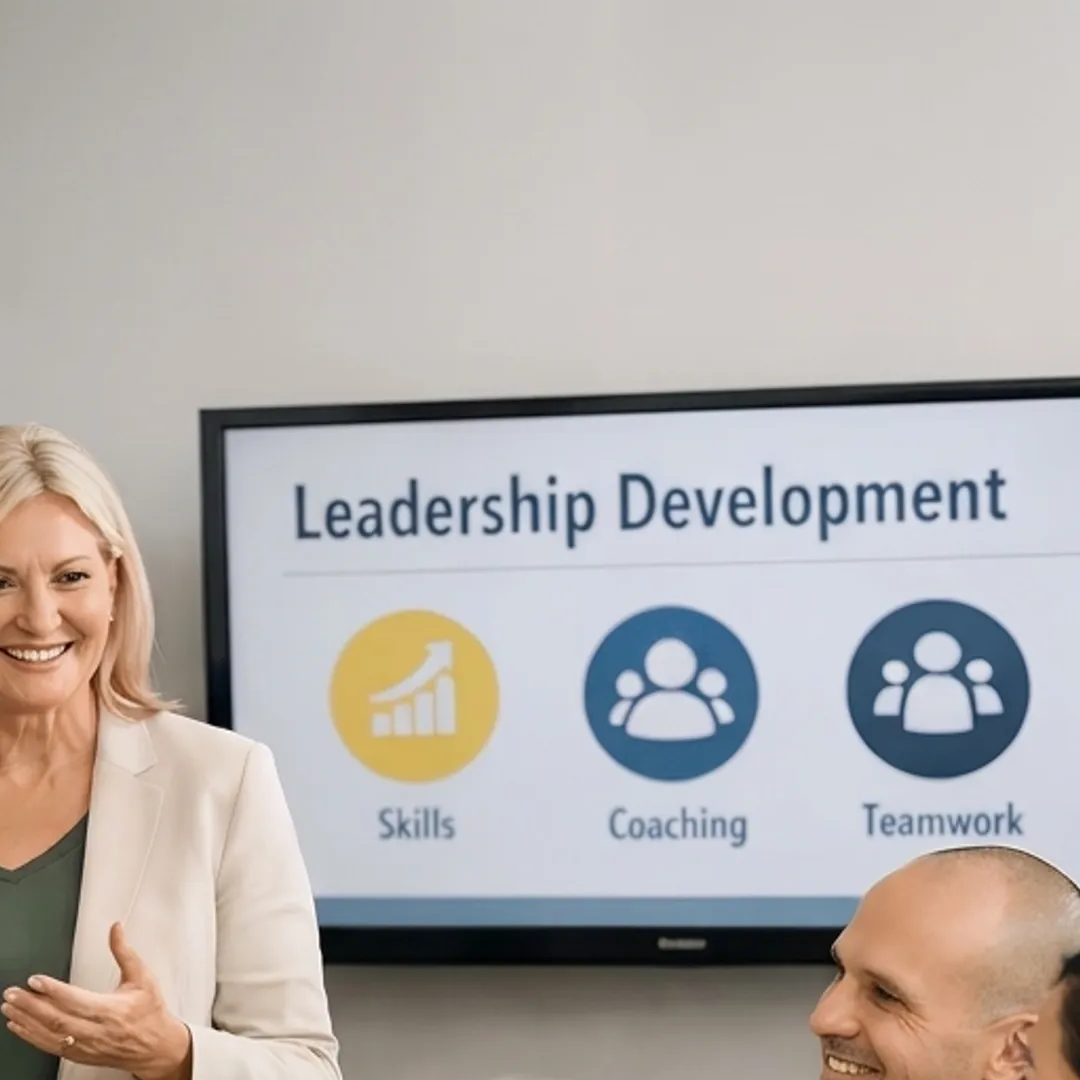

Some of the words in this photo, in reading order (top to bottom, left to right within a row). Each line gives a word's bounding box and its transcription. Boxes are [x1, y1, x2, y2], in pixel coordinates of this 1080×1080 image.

[293, 475, 597, 548] Leadership
[618, 466, 1008, 542] Development
[377, 806, 456, 841] Skills
[608, 807, 749, 848] Coaching
[862, 802, 1024, 838] Teamwork
